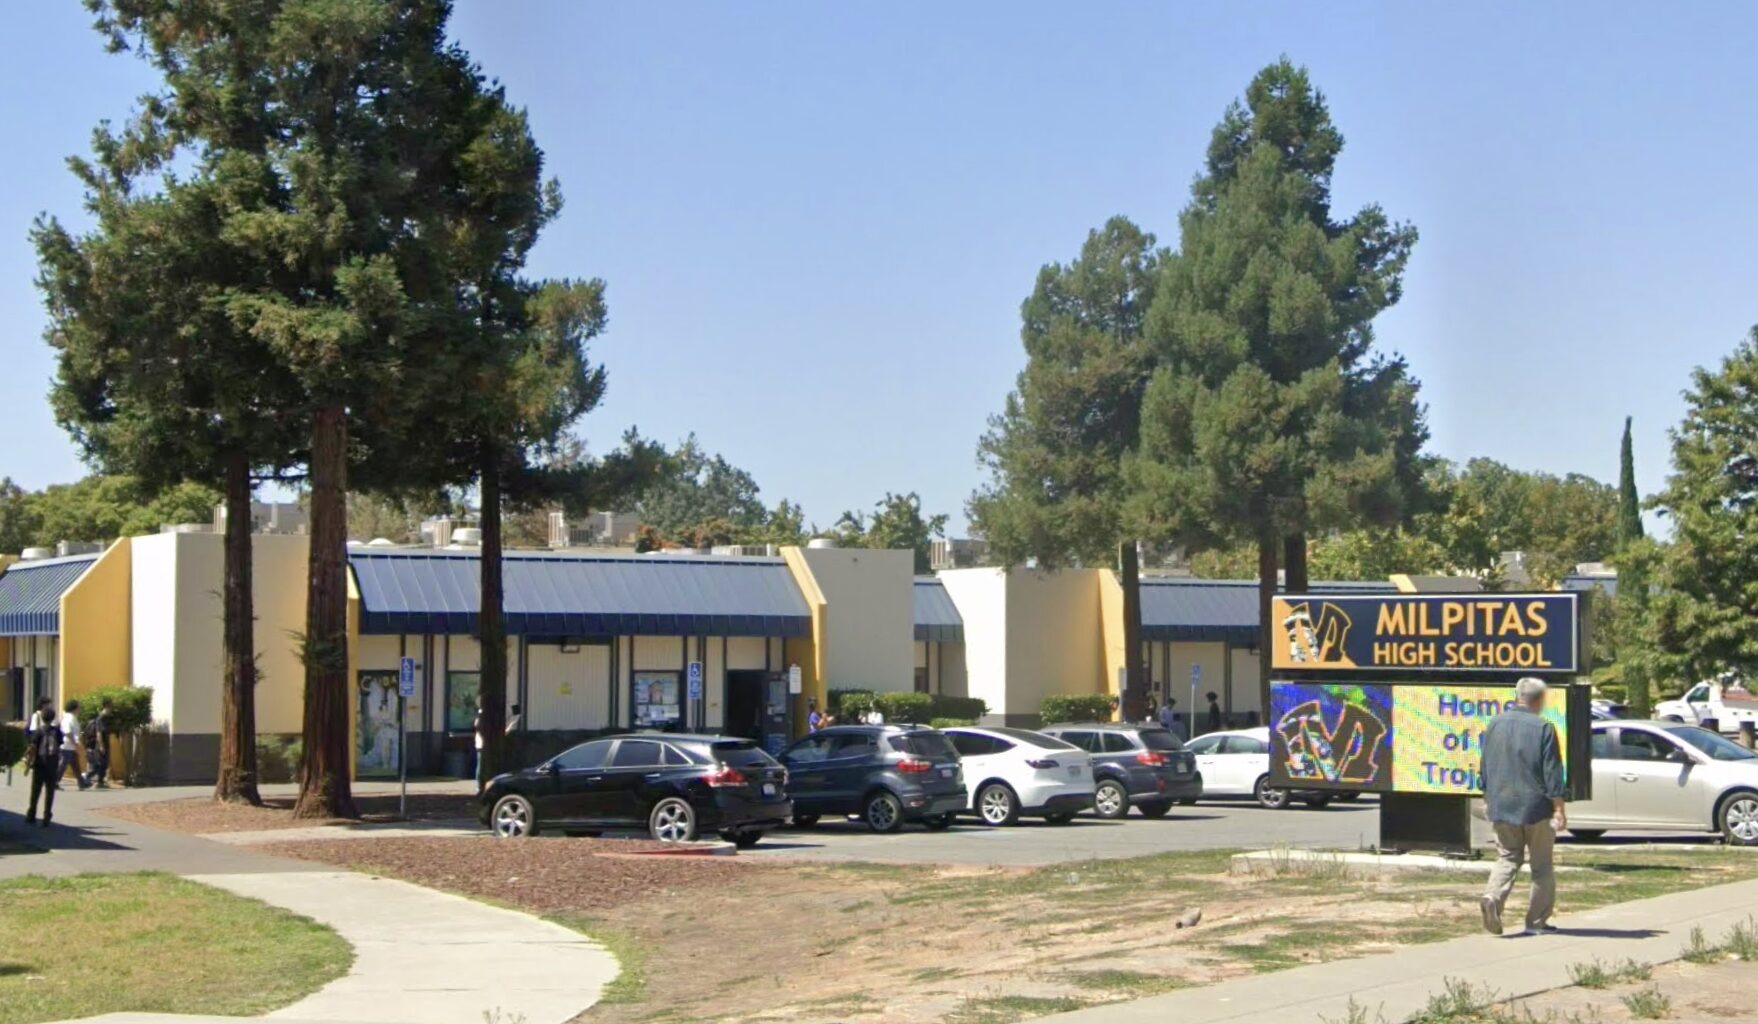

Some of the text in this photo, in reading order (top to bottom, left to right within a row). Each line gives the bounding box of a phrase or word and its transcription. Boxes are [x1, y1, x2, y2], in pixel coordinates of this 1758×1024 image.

[1375, 601, 1548, 637] MILPITAS
[1373, 641, 1552, 667] HIGH SCHOOL
[1443, 729, 1470, 751] of
[1421, 762, 1483, 790] Troj
